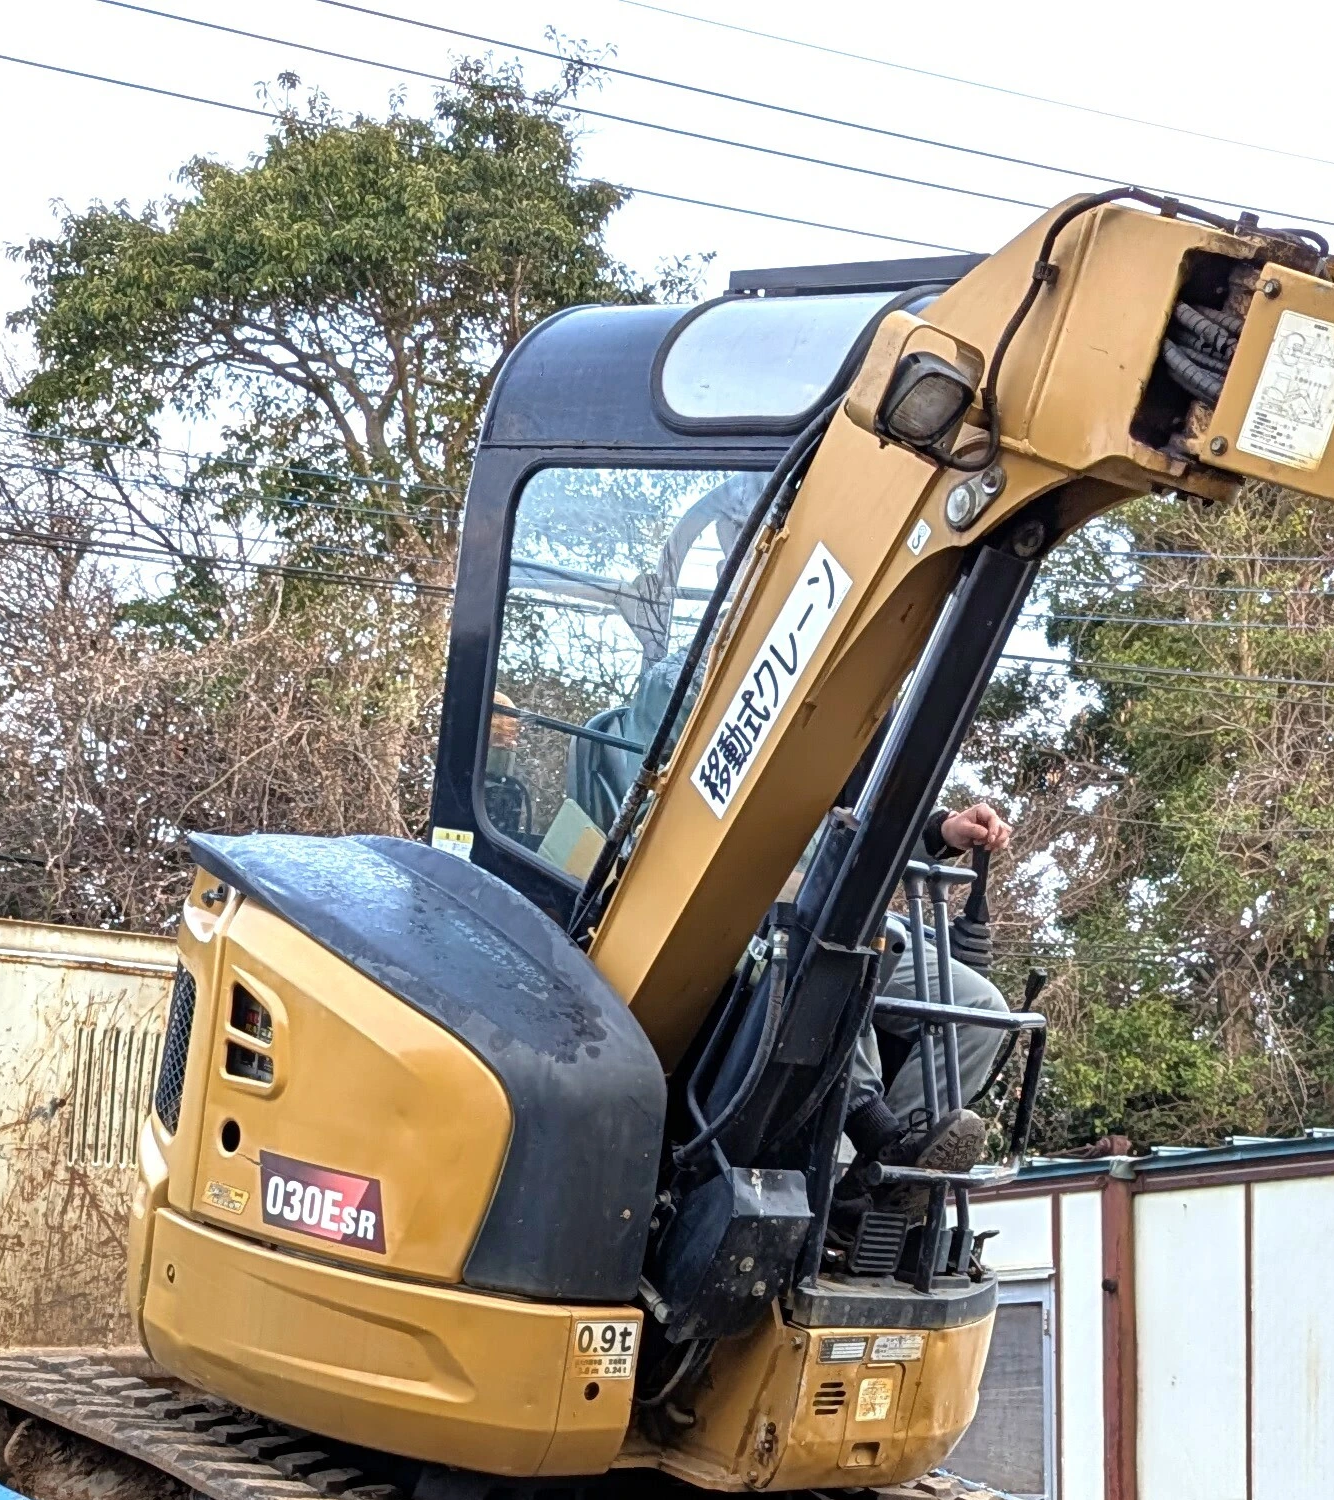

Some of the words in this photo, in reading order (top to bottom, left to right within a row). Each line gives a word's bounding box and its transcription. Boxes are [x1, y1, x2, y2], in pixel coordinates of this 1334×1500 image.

[699, 558, 835, 805] 移動式クレーン
